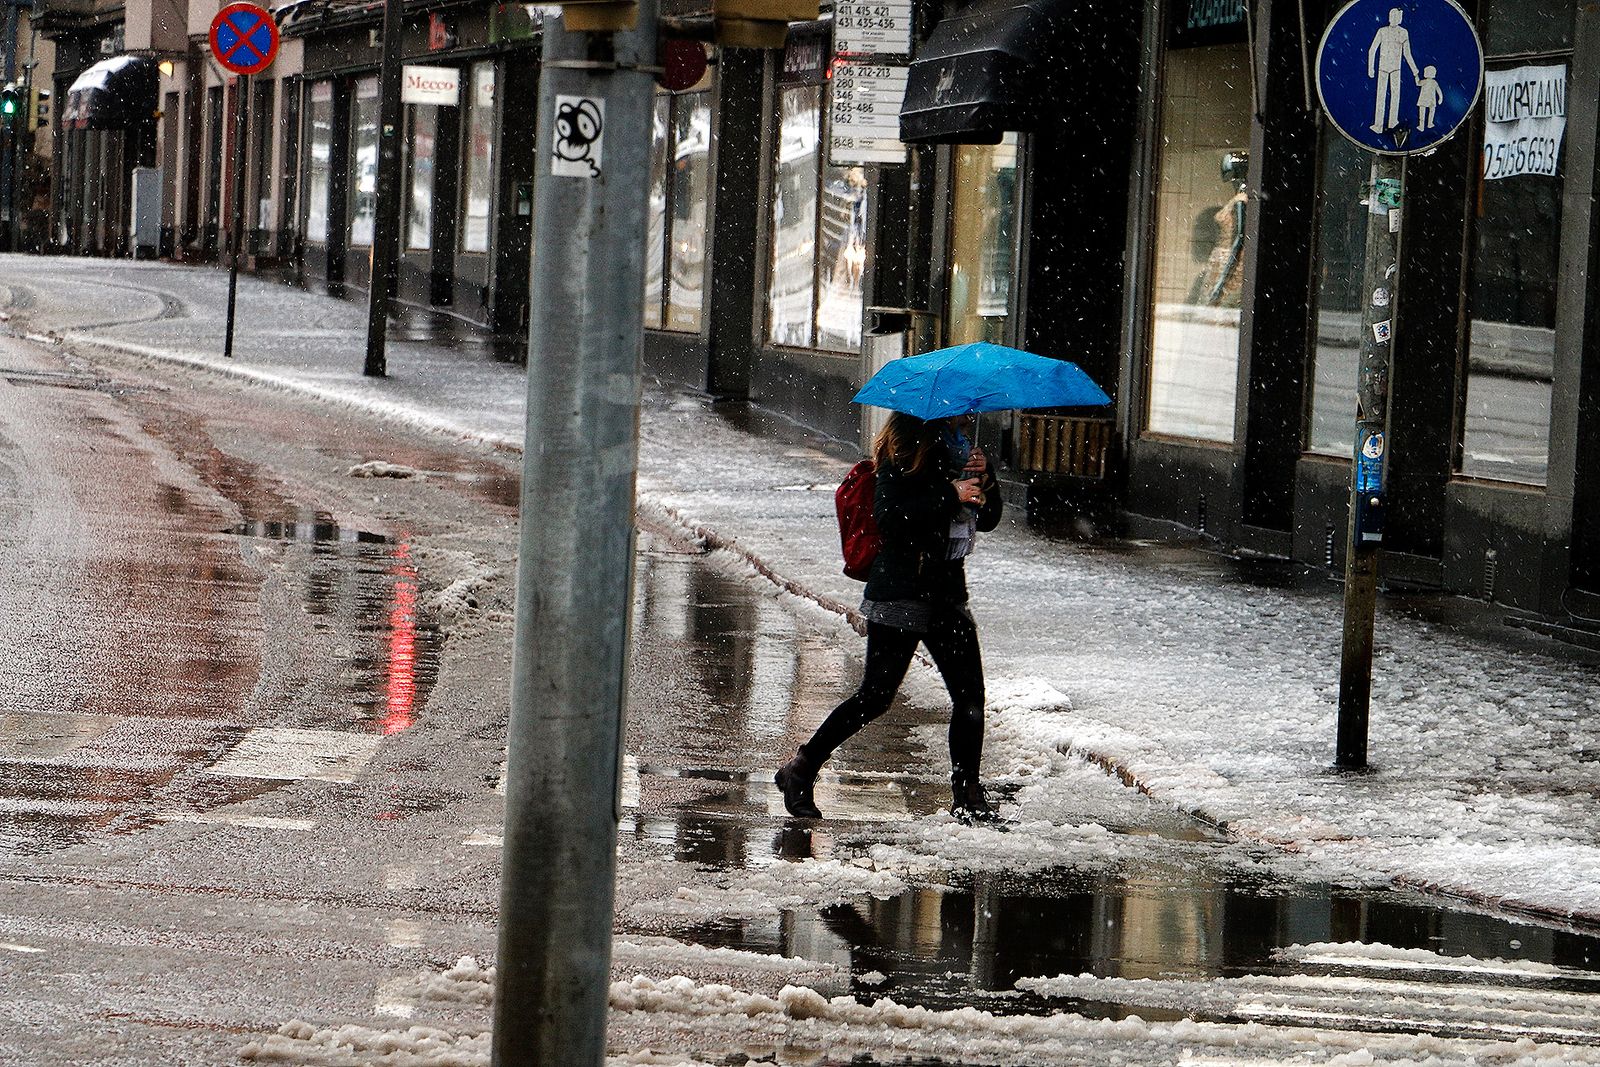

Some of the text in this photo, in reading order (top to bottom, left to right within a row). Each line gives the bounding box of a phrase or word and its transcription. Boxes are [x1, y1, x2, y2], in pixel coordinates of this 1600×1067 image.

[838, 5, 890, 17] 411 415 421
[838, 17, 896, 29] 431 435-436
[838, 41, 849, 51] 63
[836, 66, 891, 78] 206 212-213
[836, 78, 854, 89] 280
[836, 90, 854, 101] 346
[835, 103, 874, 114] 455-486
[835, 113, 853, 124] 662
